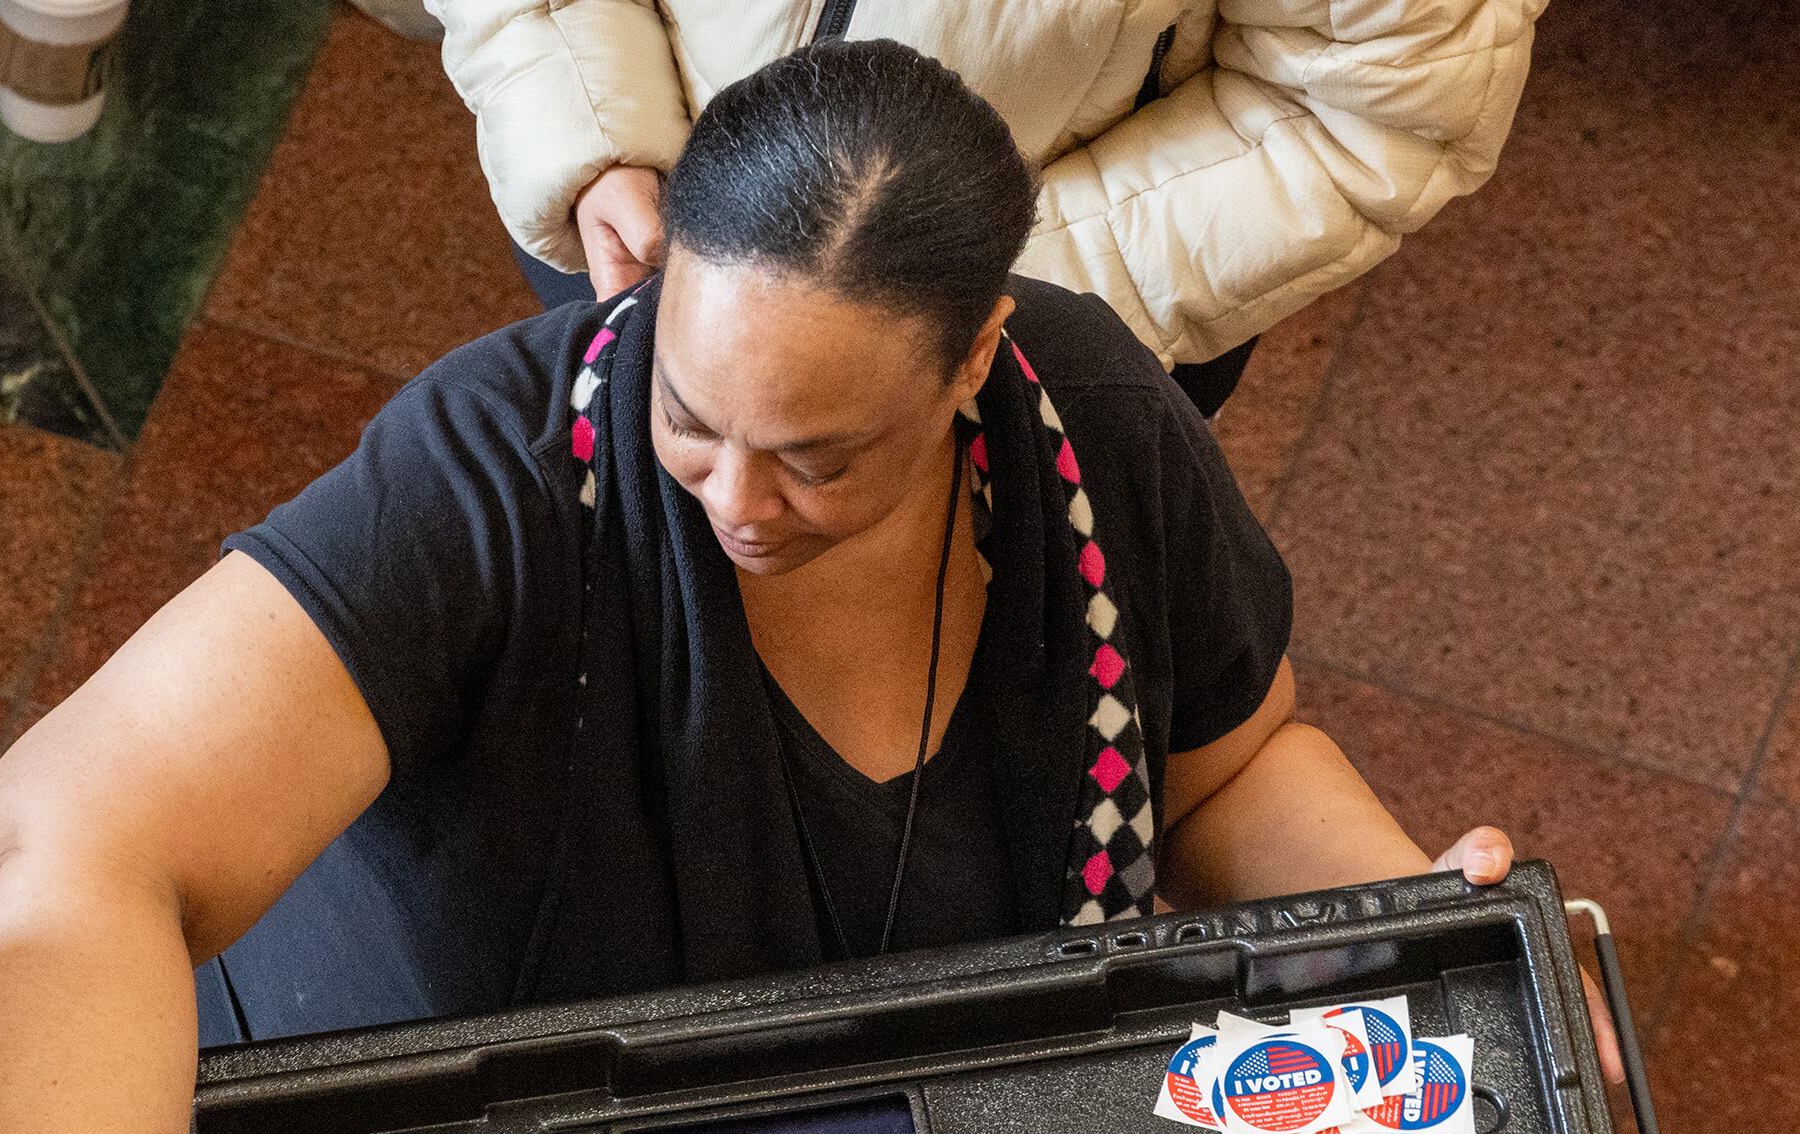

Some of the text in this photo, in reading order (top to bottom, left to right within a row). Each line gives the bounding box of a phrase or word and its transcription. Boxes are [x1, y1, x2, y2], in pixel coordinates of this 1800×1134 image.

[1180, 1060, 1191, 1074] I
[1350, 1057, 1358, 1071] I
[1235, 1070, 1321, 1094] I VOTED
[1404, 1059, 1425, 1122] VOTED
